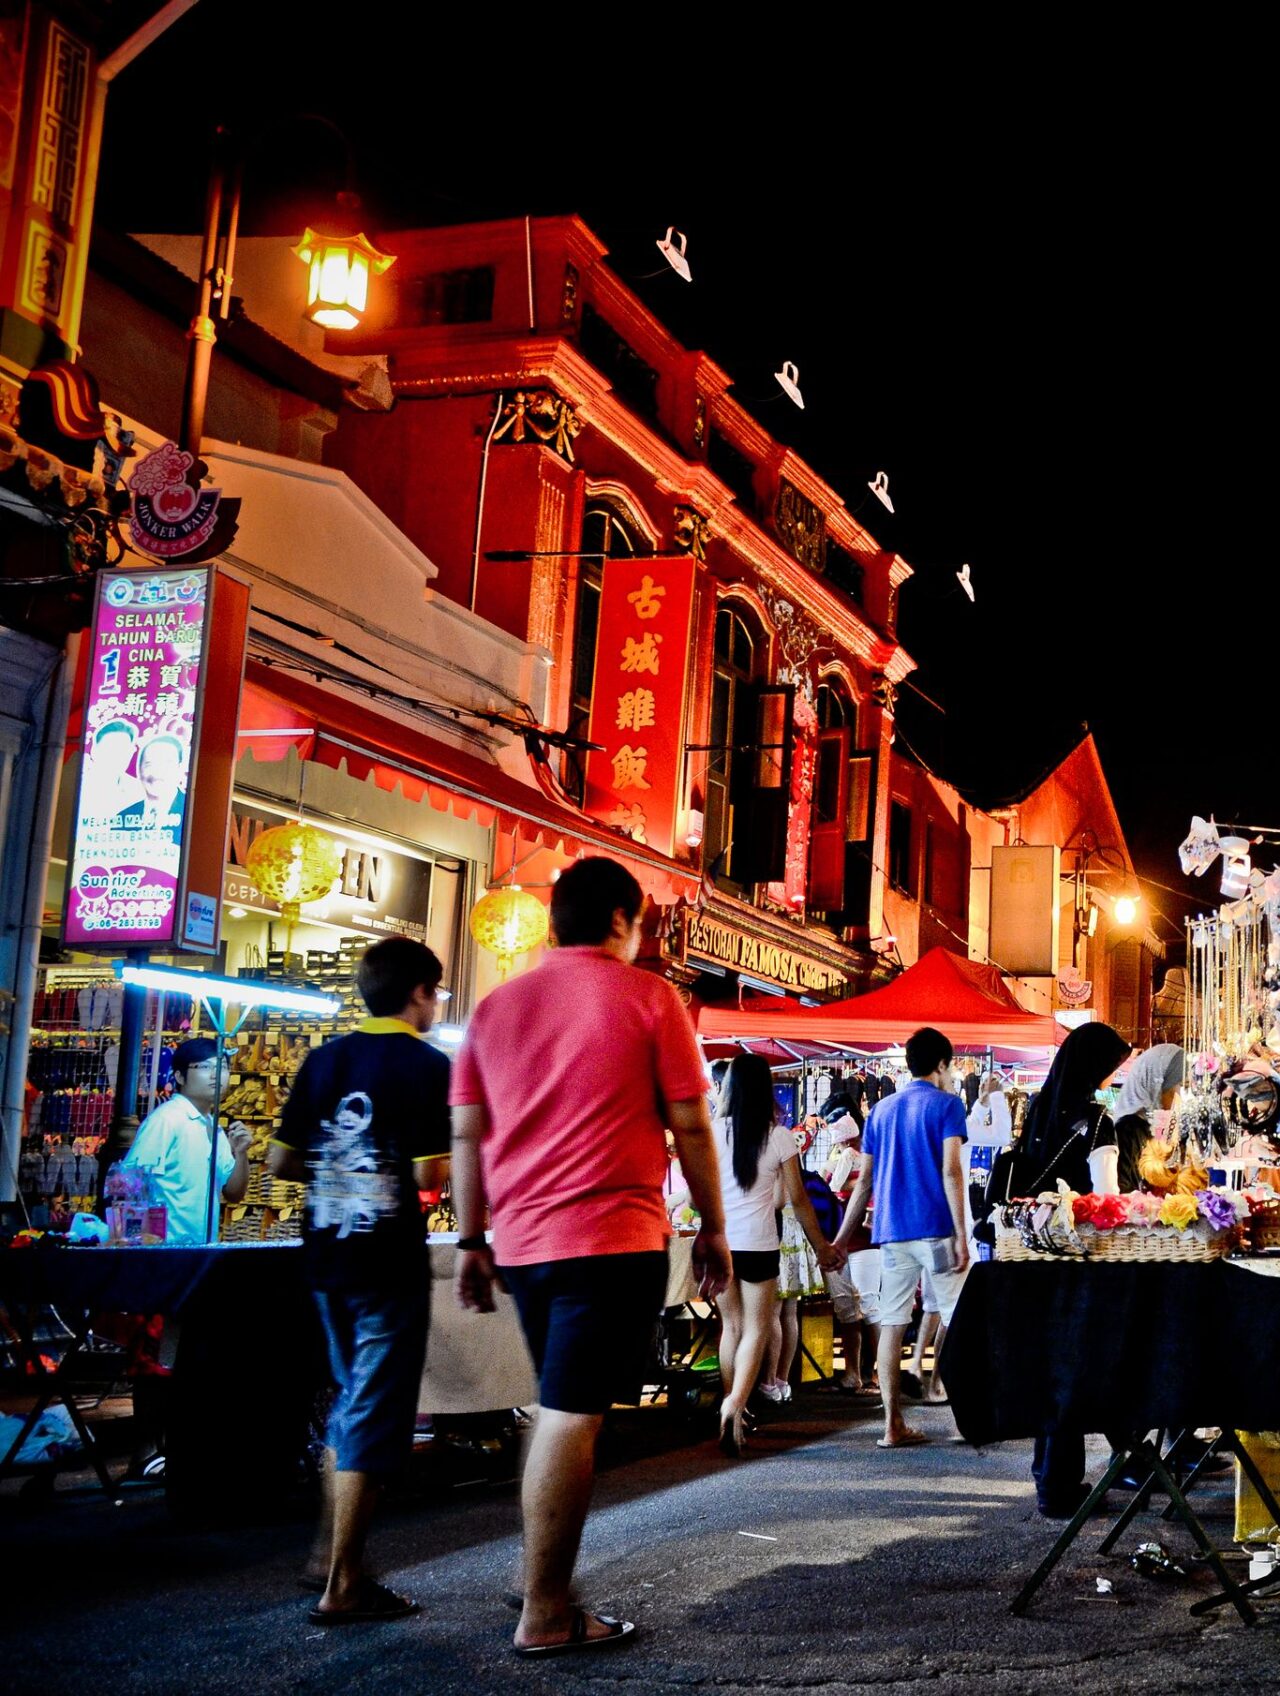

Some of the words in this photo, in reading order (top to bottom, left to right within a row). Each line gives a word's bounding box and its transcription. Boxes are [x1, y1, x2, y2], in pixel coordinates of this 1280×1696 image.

[140, 503, 177, 538] JONKER
[181, 502, 212, 533] WALK
[115, 611, 186, 628] SELAMAT
[100, 631, 150, 646] TAHUN
[154, 629, 198, 644] BARU
[128, 648, 165, 662] CINA
[79, 847, 140, 860] TEKNOLOG
[689, 917, 740, 961] RESTORAN
[739, 935, 800, 986] FAMOSA
